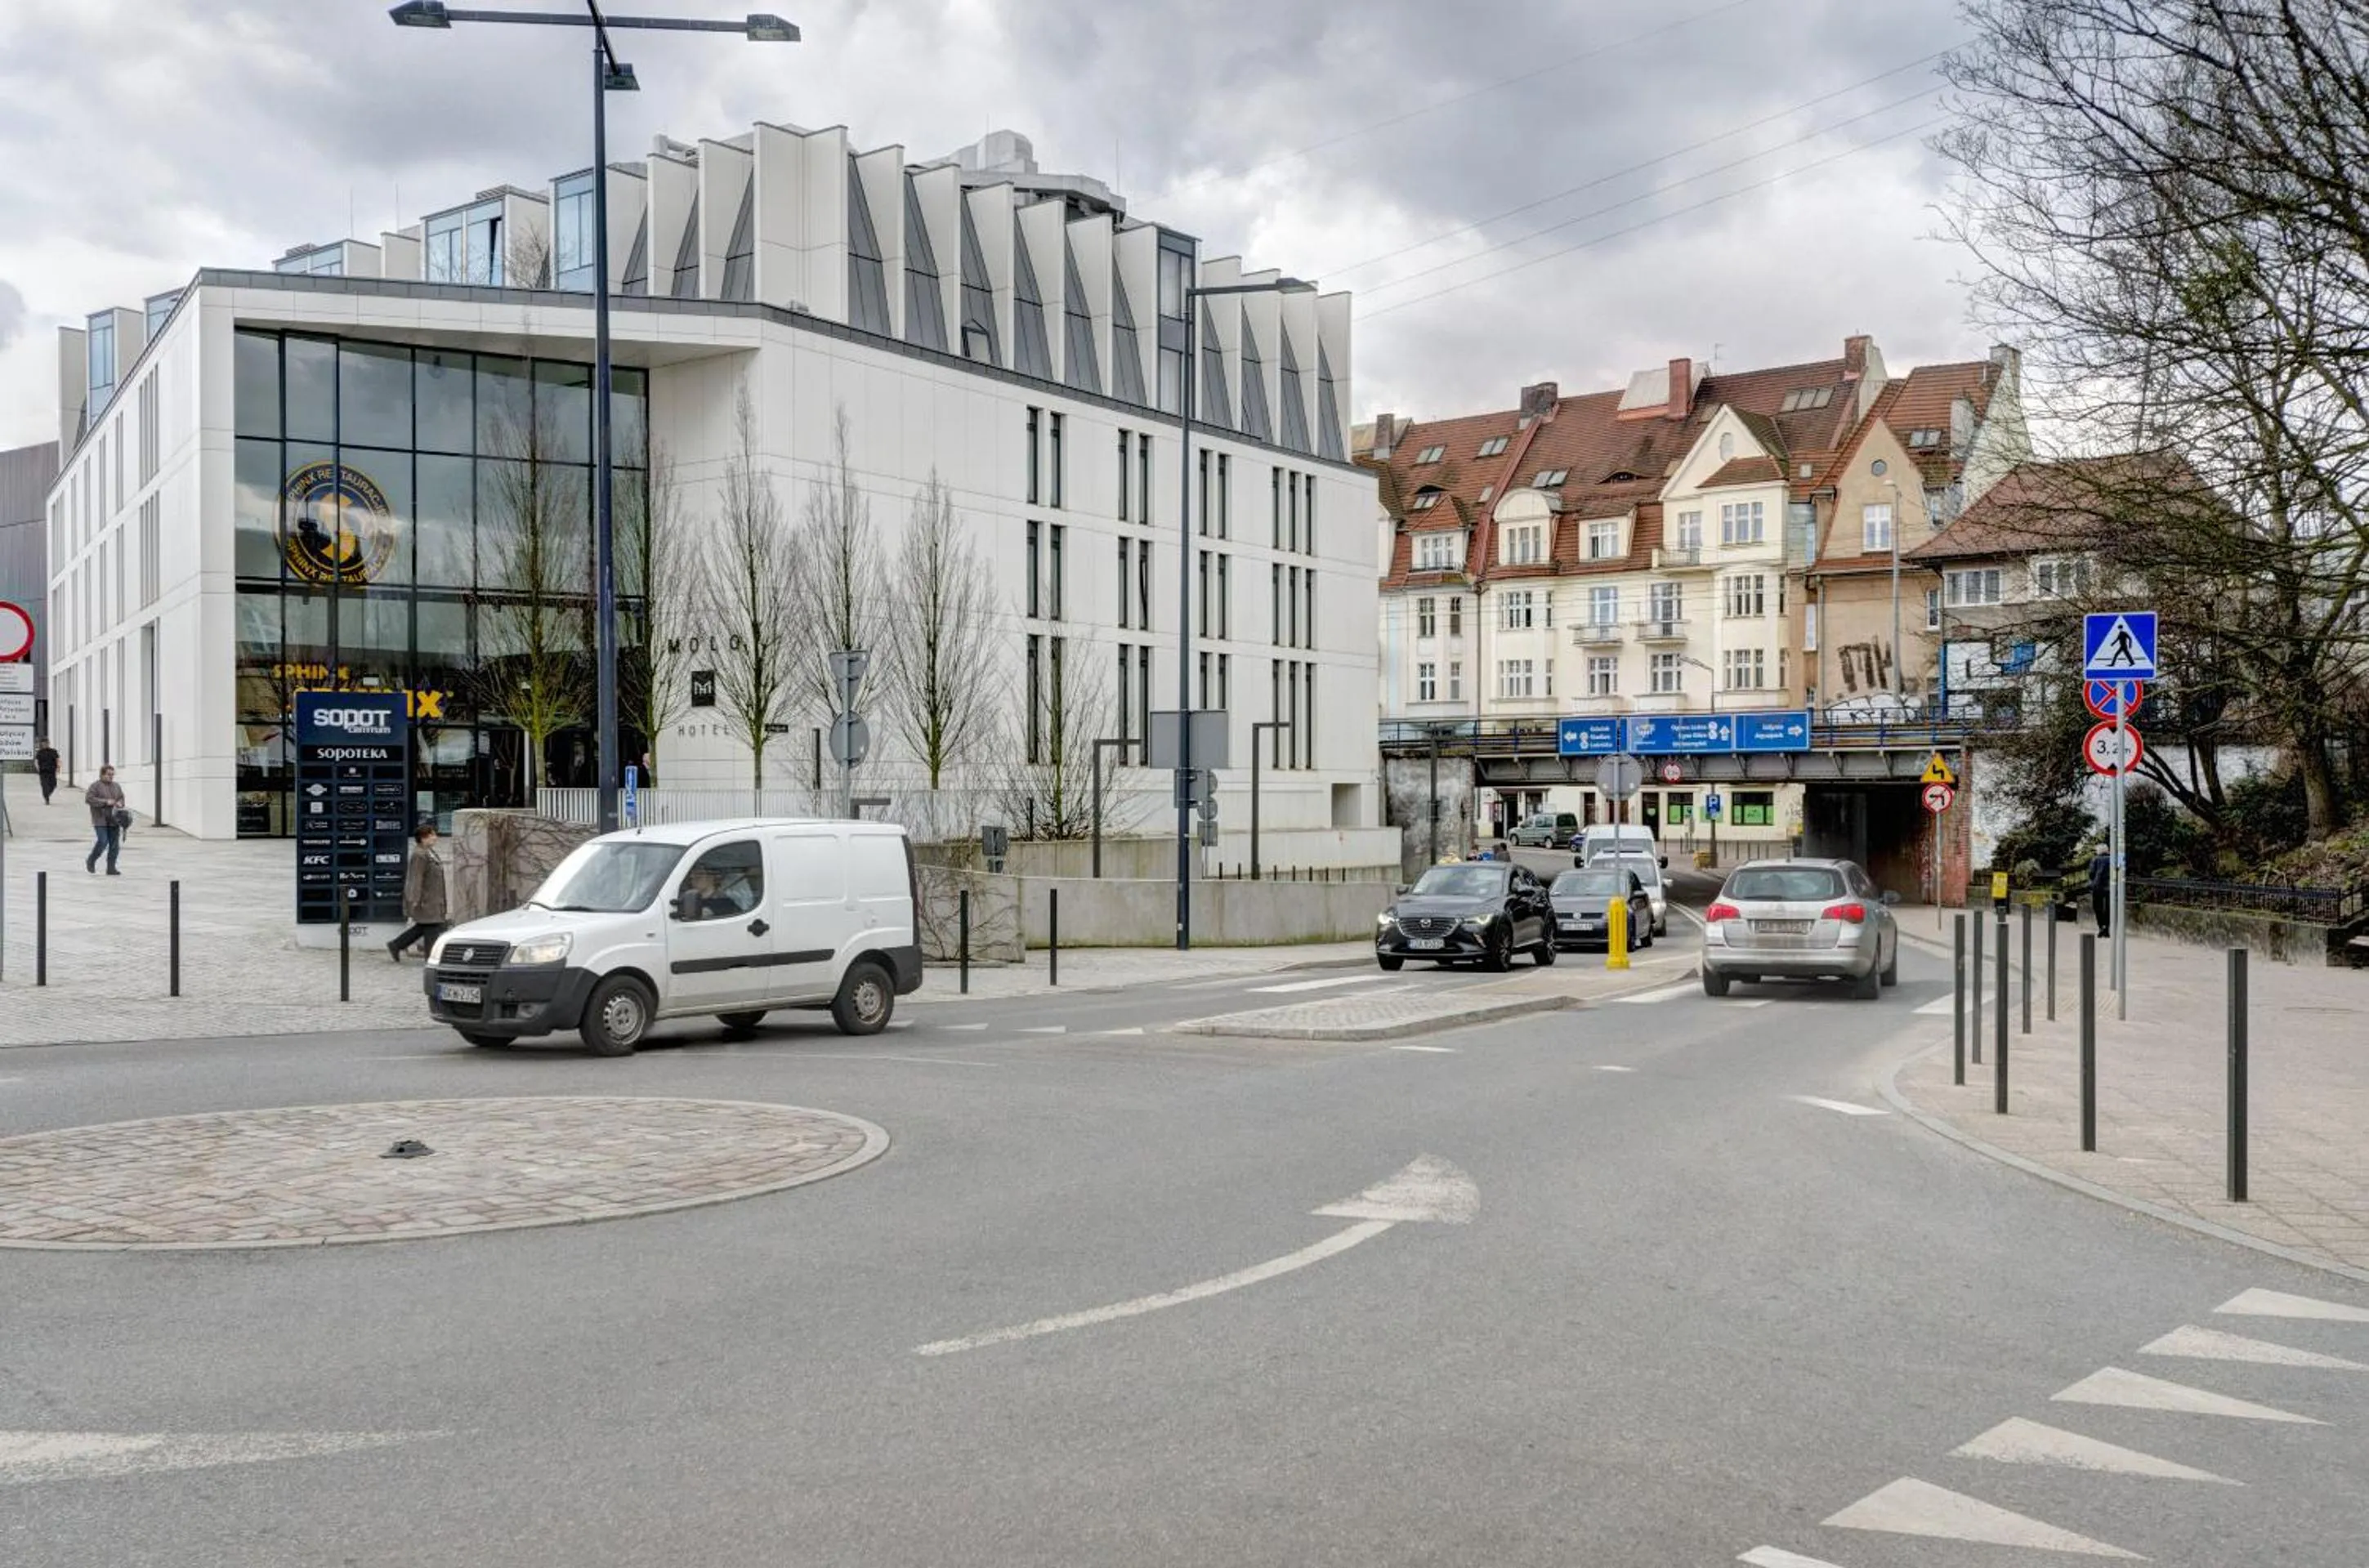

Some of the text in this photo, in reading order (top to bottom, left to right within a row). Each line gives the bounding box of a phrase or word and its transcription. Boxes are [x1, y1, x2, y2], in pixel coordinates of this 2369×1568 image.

[668, 634, 740, 654] MOLO
[313, 708, 391, 730] SOPOT
[677, 723, 730, 737] HOTEL
[317, 748, 388, 762] SOPOTEKA
[303, 855, 329, 864] KFC
